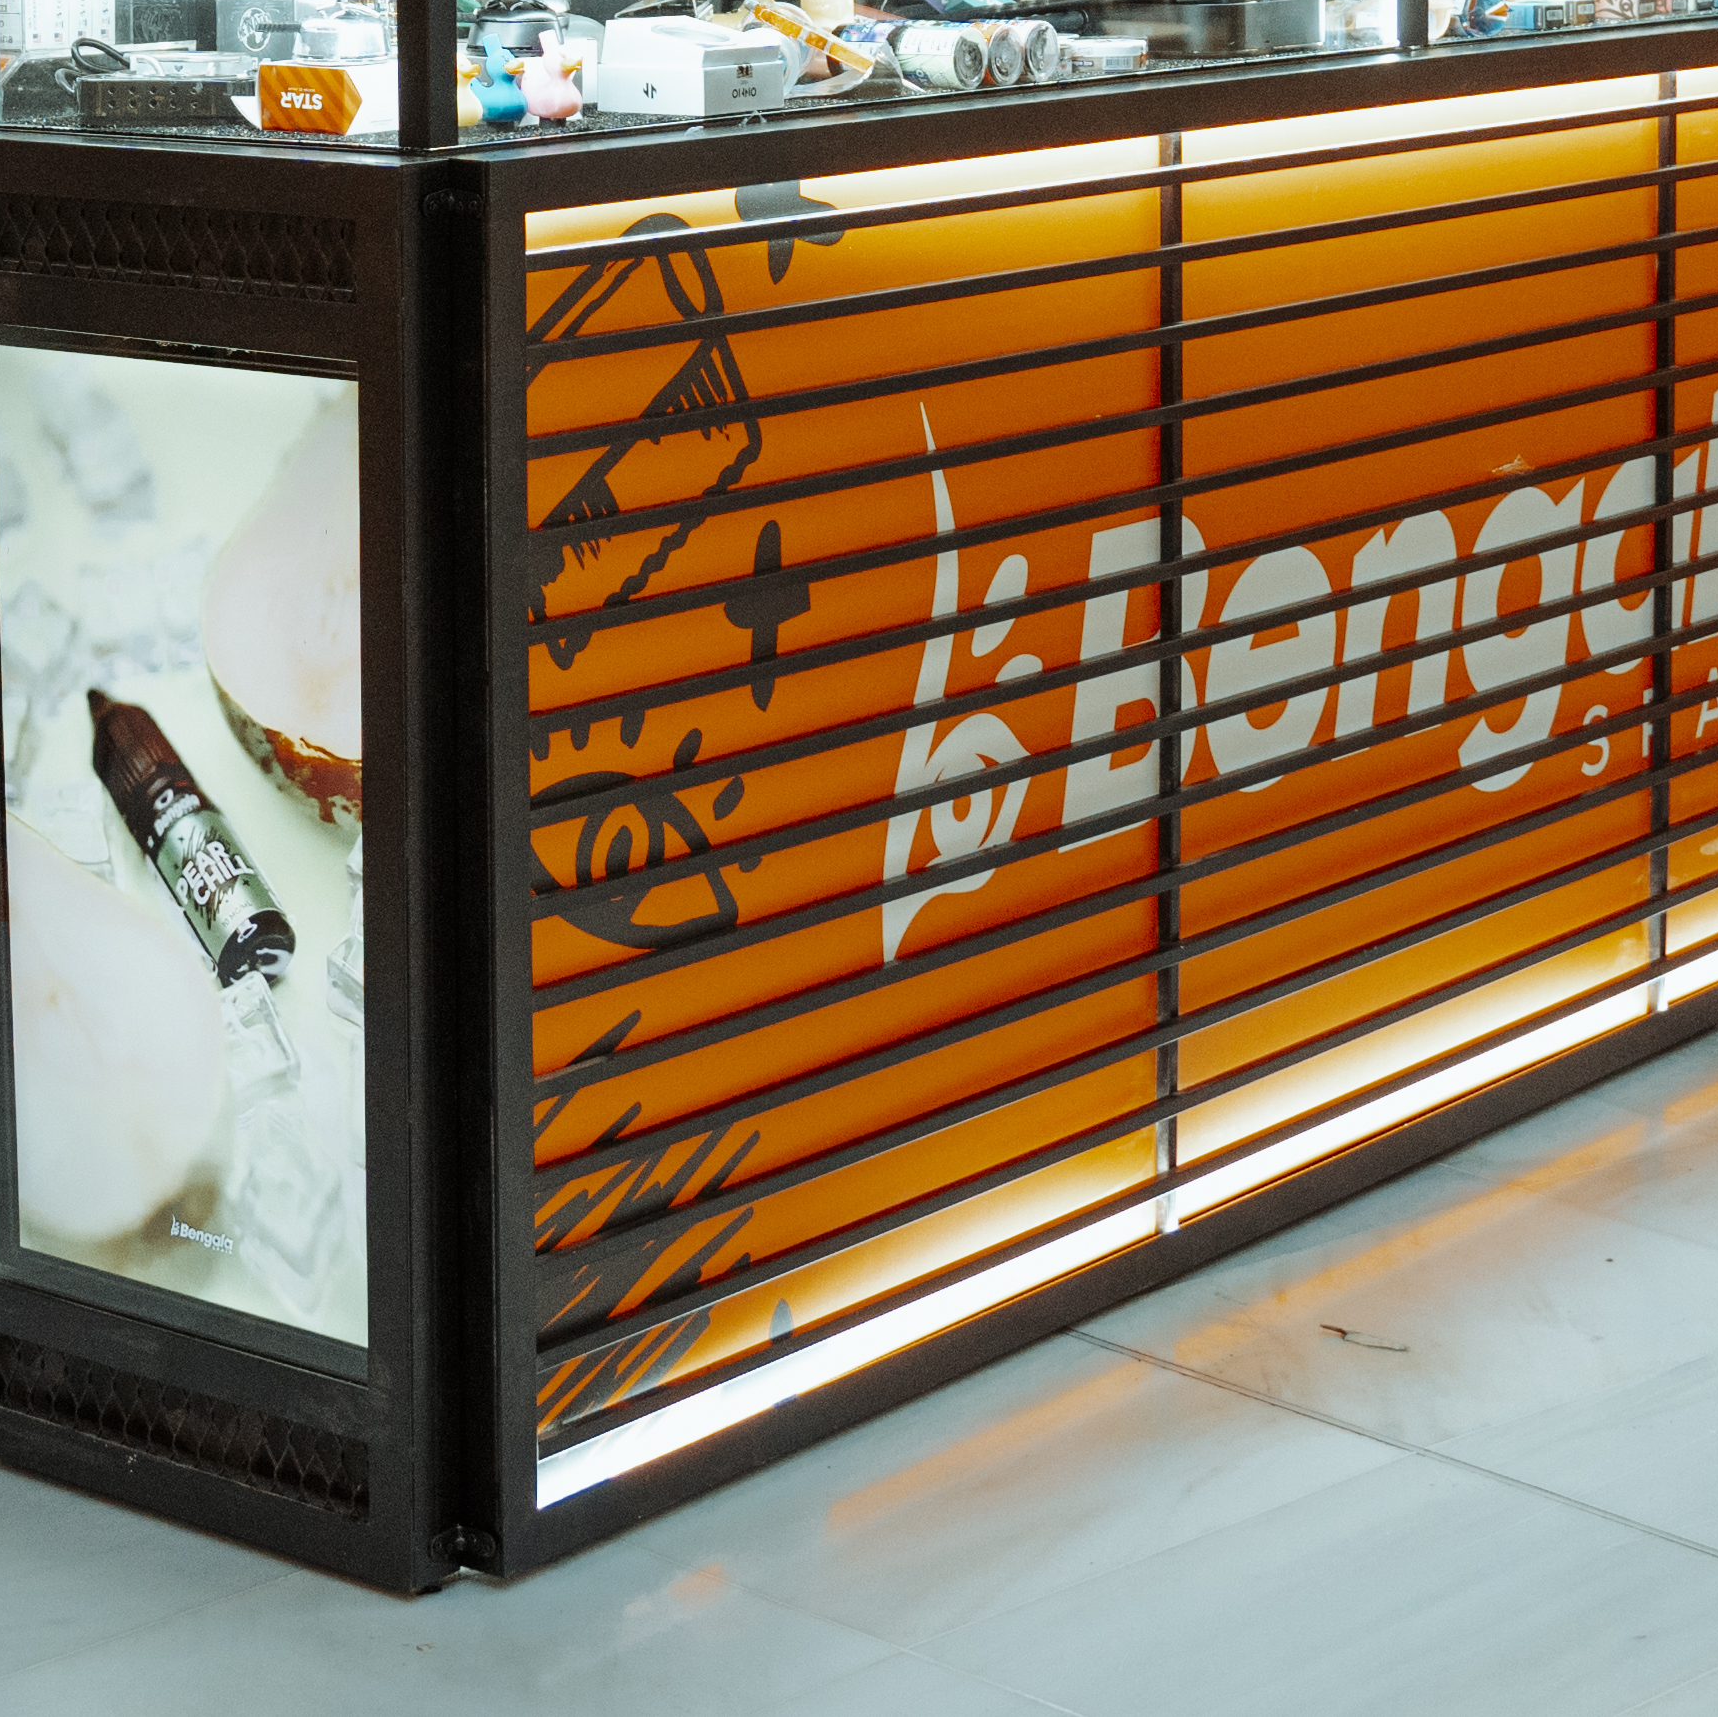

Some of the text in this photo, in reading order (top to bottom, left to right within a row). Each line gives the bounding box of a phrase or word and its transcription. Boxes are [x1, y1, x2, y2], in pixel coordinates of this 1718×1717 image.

[280, 91, 323, 110] STAR
[176, 840, 230, 905] PEAR
[194, 854, 255, 906] CHILL
[179, 1221, 234, 1249] Bengala
